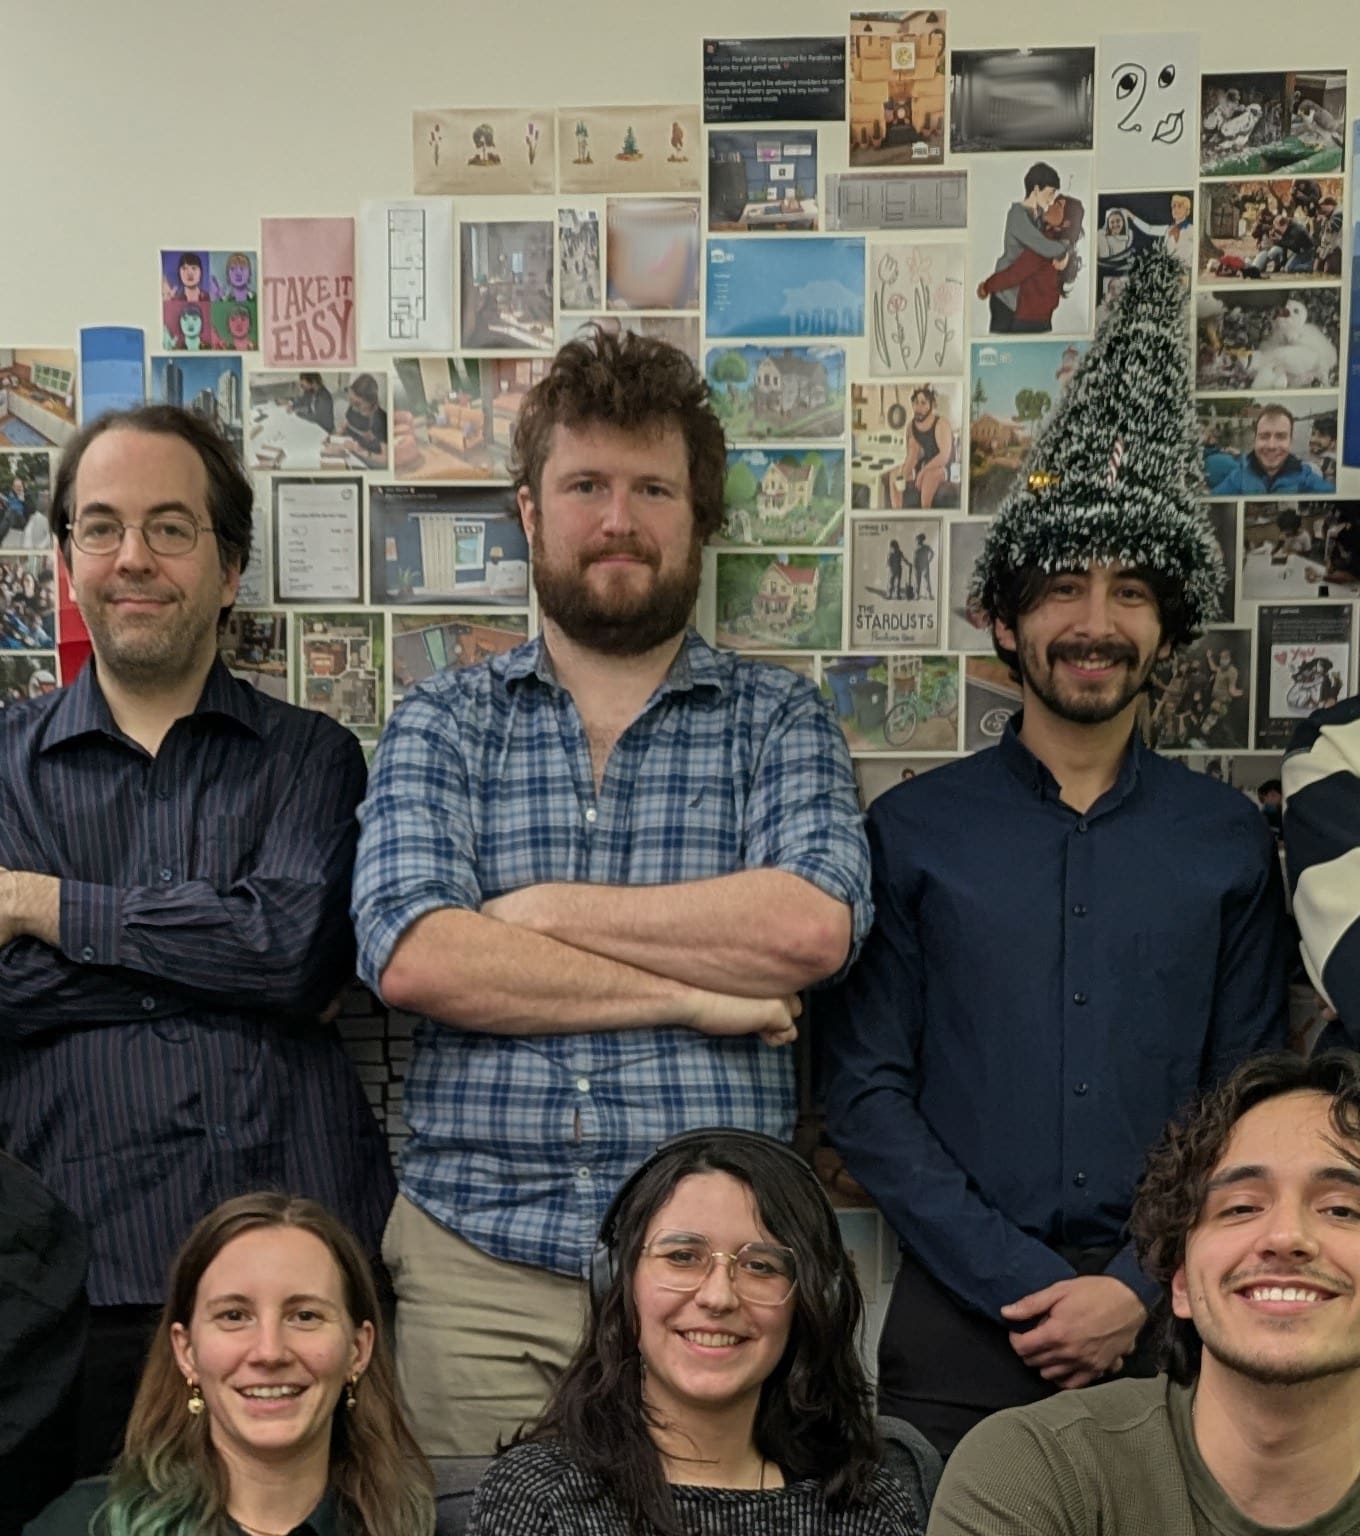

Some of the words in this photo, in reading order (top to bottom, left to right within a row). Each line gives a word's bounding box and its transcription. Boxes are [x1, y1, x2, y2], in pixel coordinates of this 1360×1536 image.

[263, 276, 331, 322] TAKE
[335, 276, 352, 297] IT
[272, 299, 353, 361] EASY
[856, 612, 934, 630] STARDUSTS
